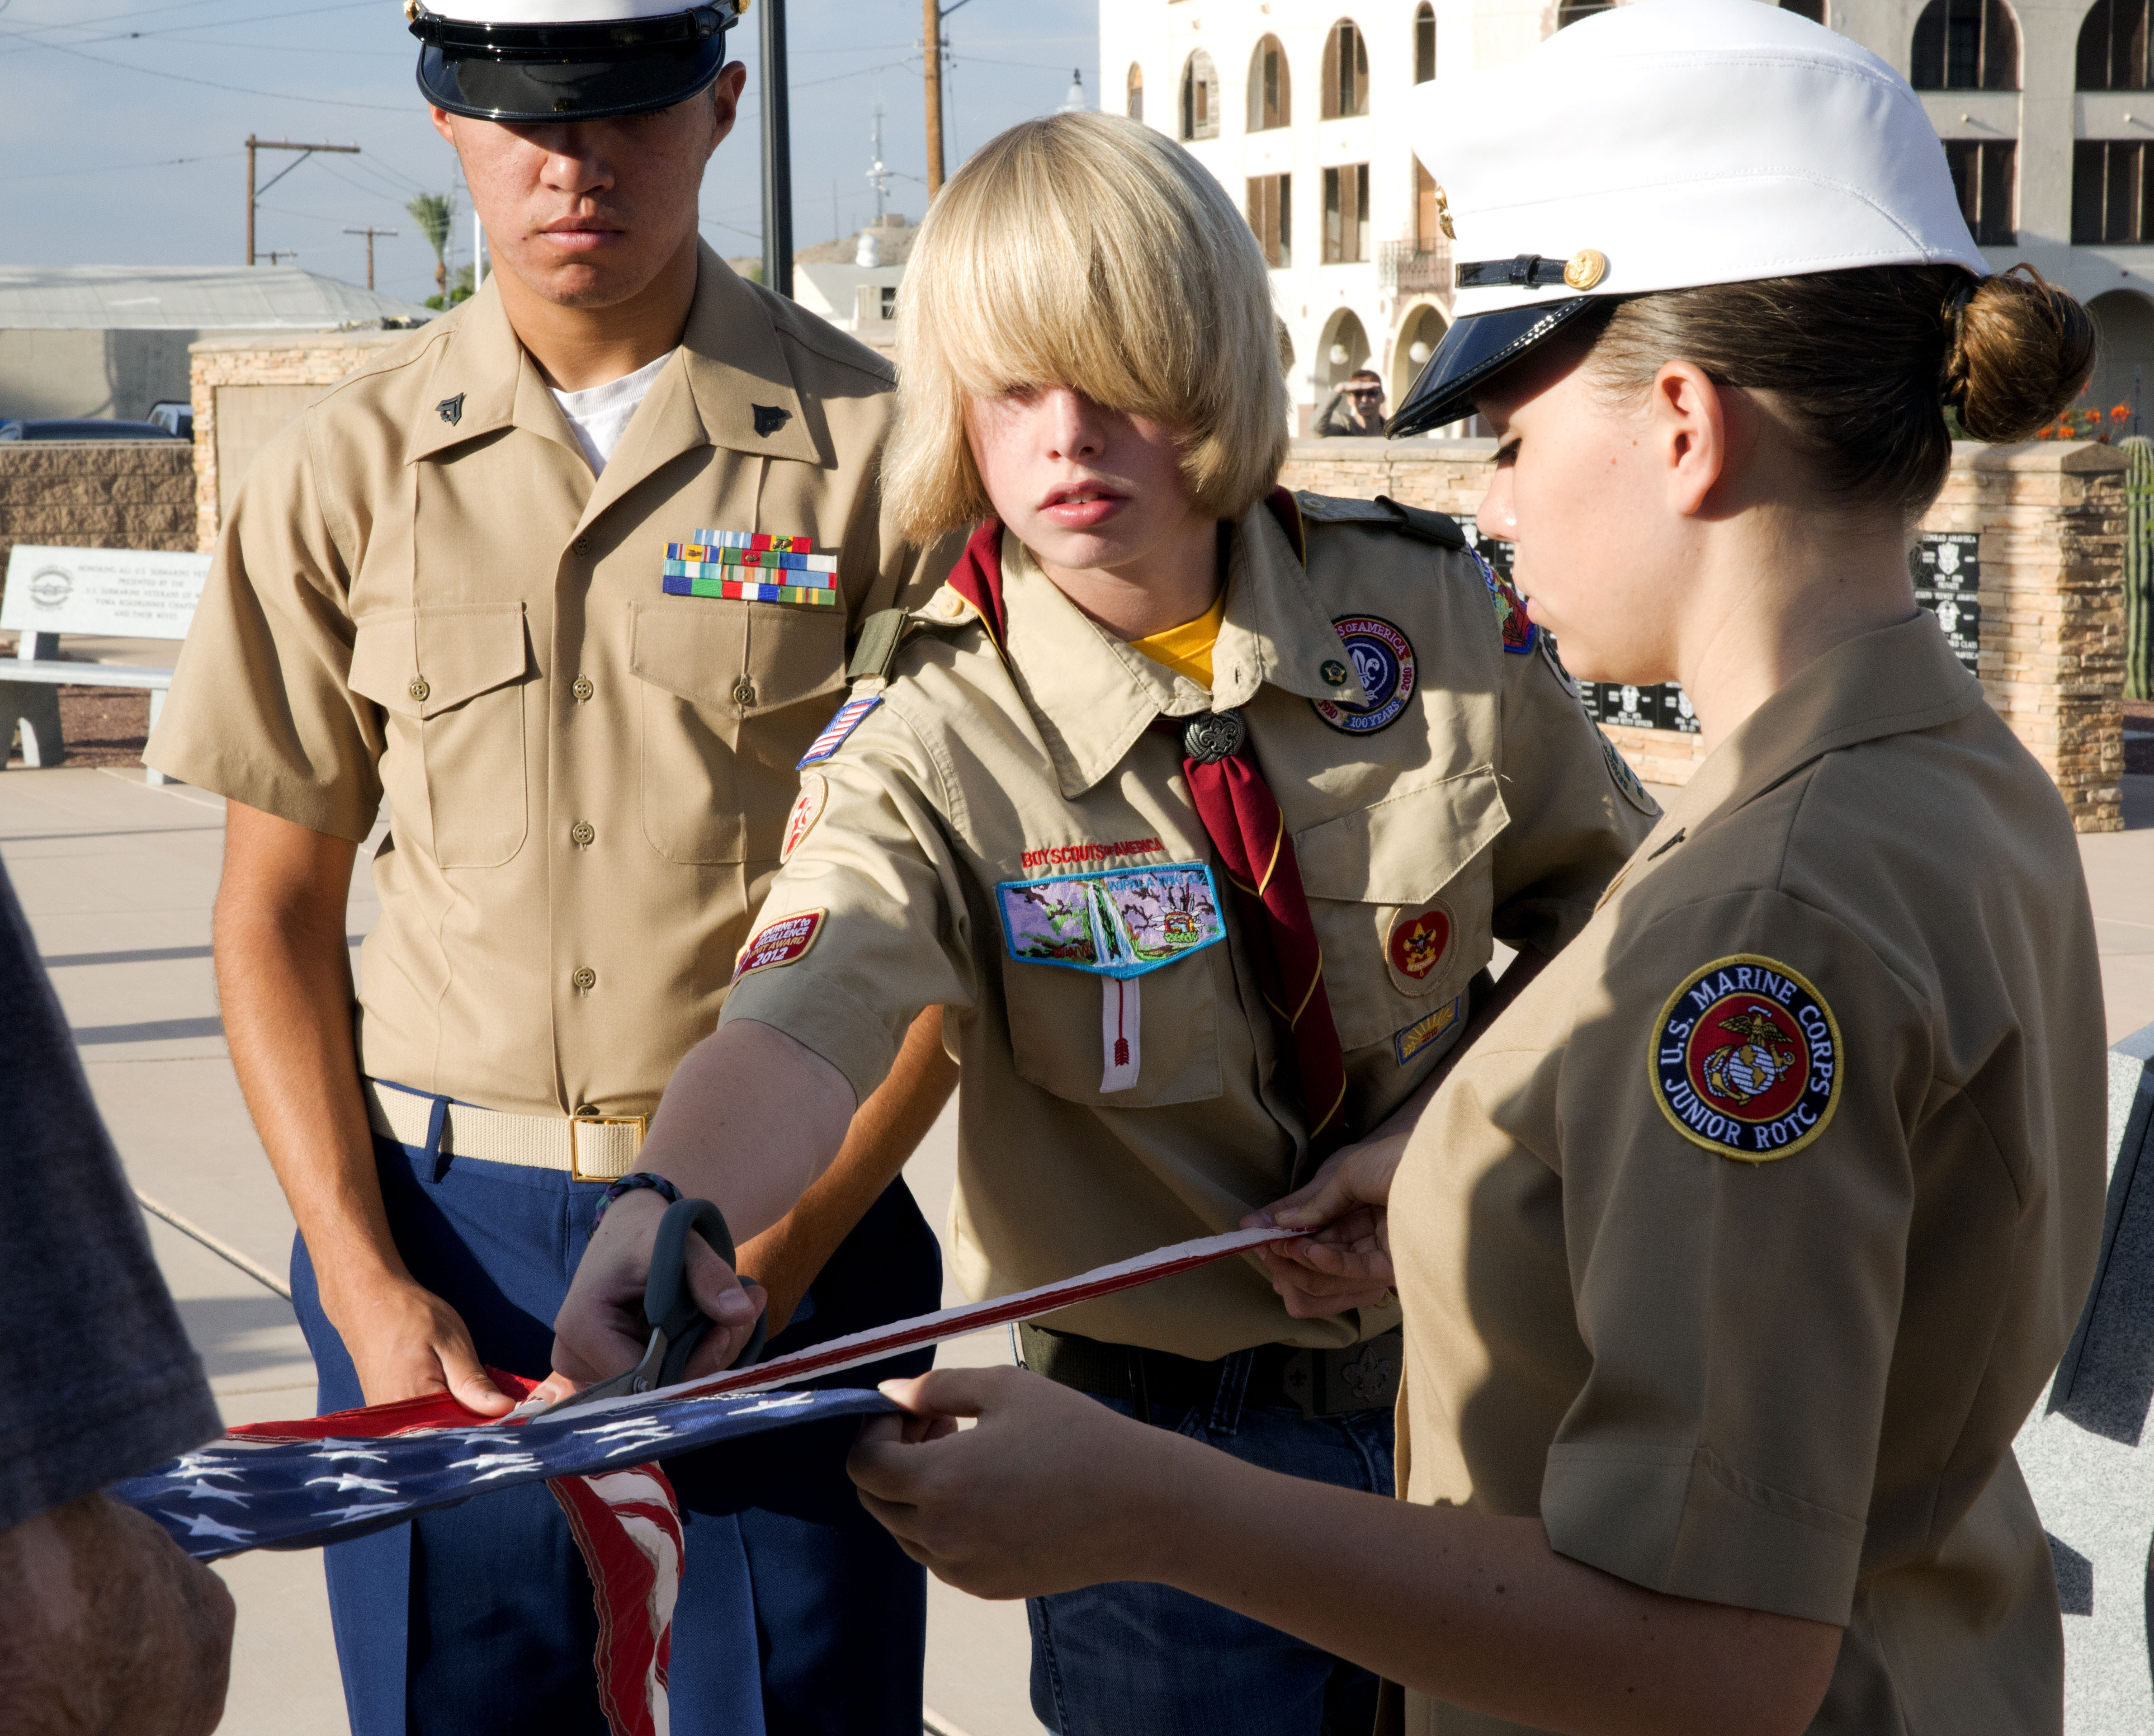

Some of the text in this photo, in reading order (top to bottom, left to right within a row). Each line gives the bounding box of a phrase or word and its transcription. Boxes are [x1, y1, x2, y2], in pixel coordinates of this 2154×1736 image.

[118, 578, 156, 586] PRESENTED
[150, 567, 189, 576] SUBMARINE
[101, 588, 140, 596] SUBMARINE
[144, 590, 179, 598] VETERANS
[119, 599, 165, 608] ROADRUNNER
[1346, 623, 1357, 632] OF
[1357, 622, 1406, 655] AMERICA
[1401, 667, 1412, 691] 2010
[1350, 701, 1400, 728] 100 YEARS
[1021, 849, 1049, 868] BOY
[1049, 844, 1105, 863] SCOUTS
[1114, 837, 1166, 856] AMERICA
[1108, 877, 1155, 892] WIPALA
[1157, 874, 1183, 886] WIKI
[754, 926, 809, 949] EXCELLENCE
[759, 918, 802, 941] JOURNEY
[769, 936, 805, 950] AWARD
[751, 947, 789, 967] 2012
[1661, 967, 1834, 1096] U.S. MARINE CORPS
[1666, 1079, 1817, 1149] JUNIOR ROTC
